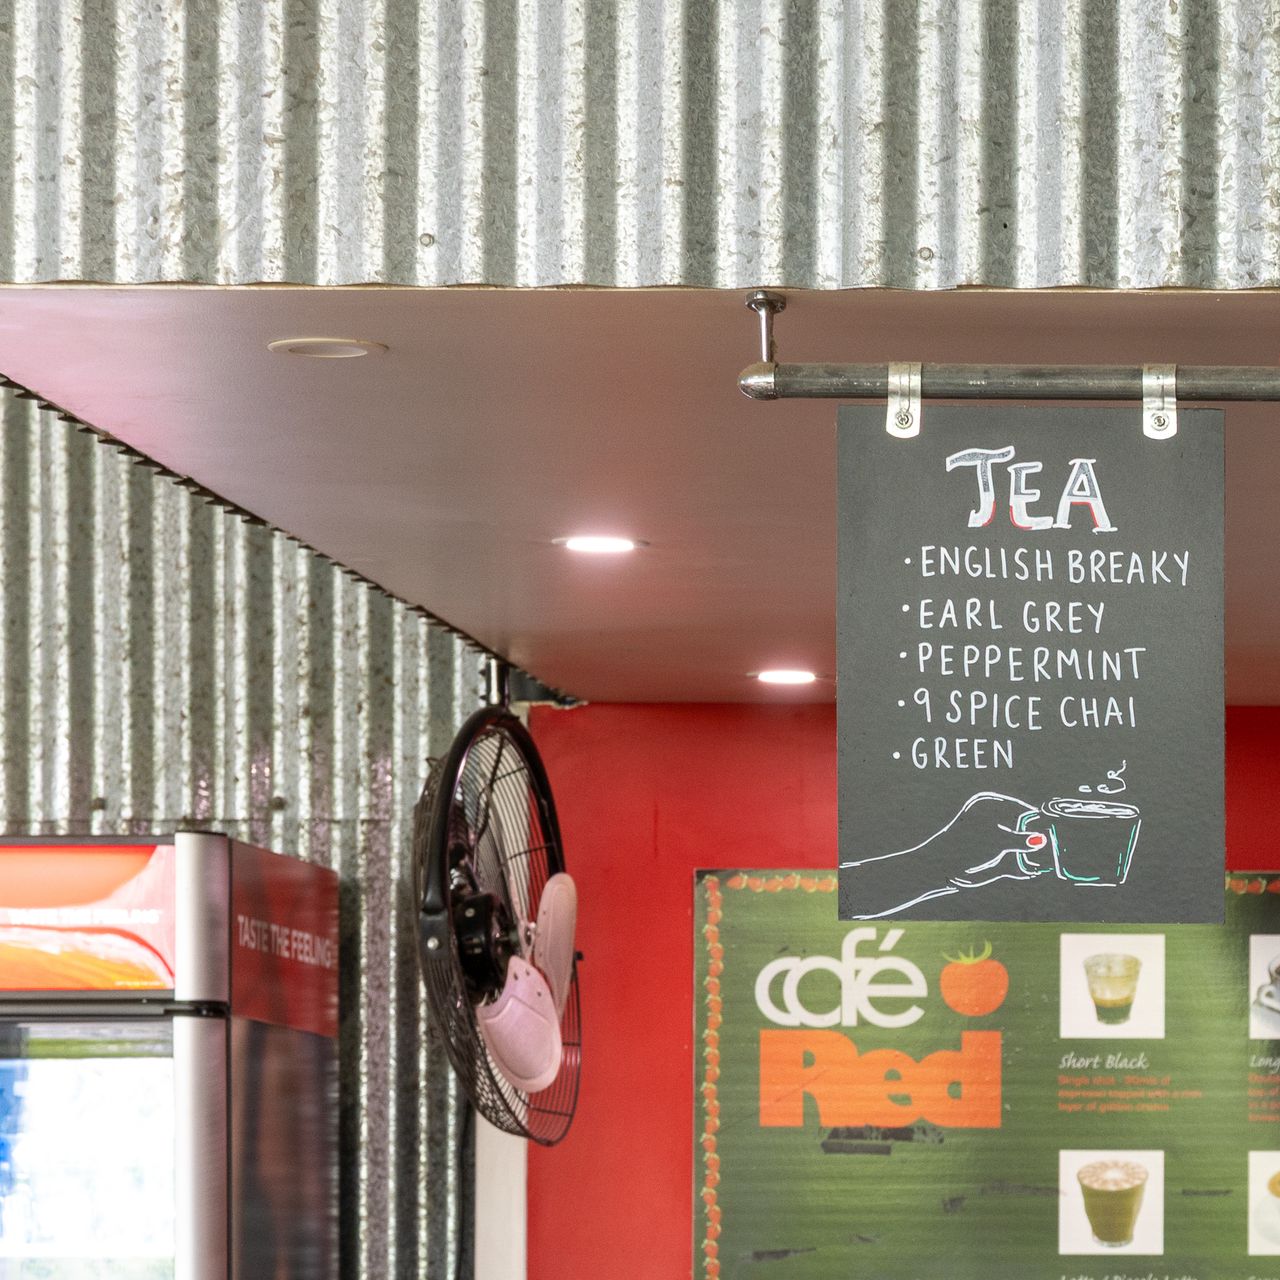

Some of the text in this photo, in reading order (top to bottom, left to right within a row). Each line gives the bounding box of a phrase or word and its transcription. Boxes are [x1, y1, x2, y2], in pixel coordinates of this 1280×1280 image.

[946, 445, 1117, 534] TEA
[921, 546, 1190, 586] ENGLISH BREAKY
[918, 598, 1105, 634] EARL GREY
[918, 642, 1147, 681] PEPPERMINT
[913, 688, 1136, 730] 9 SPICE CHAI
[912, 737, 1013, 770] GREEN
[237, 915, 331, 967] TASTE THE FEELING
[755, 928, 928, 1028] café
[760, 1029, 1001, 1128] Red
[1059, 1051, 1150, 1069] Short Black
[1250, 1054, 1280, 1074] Long
